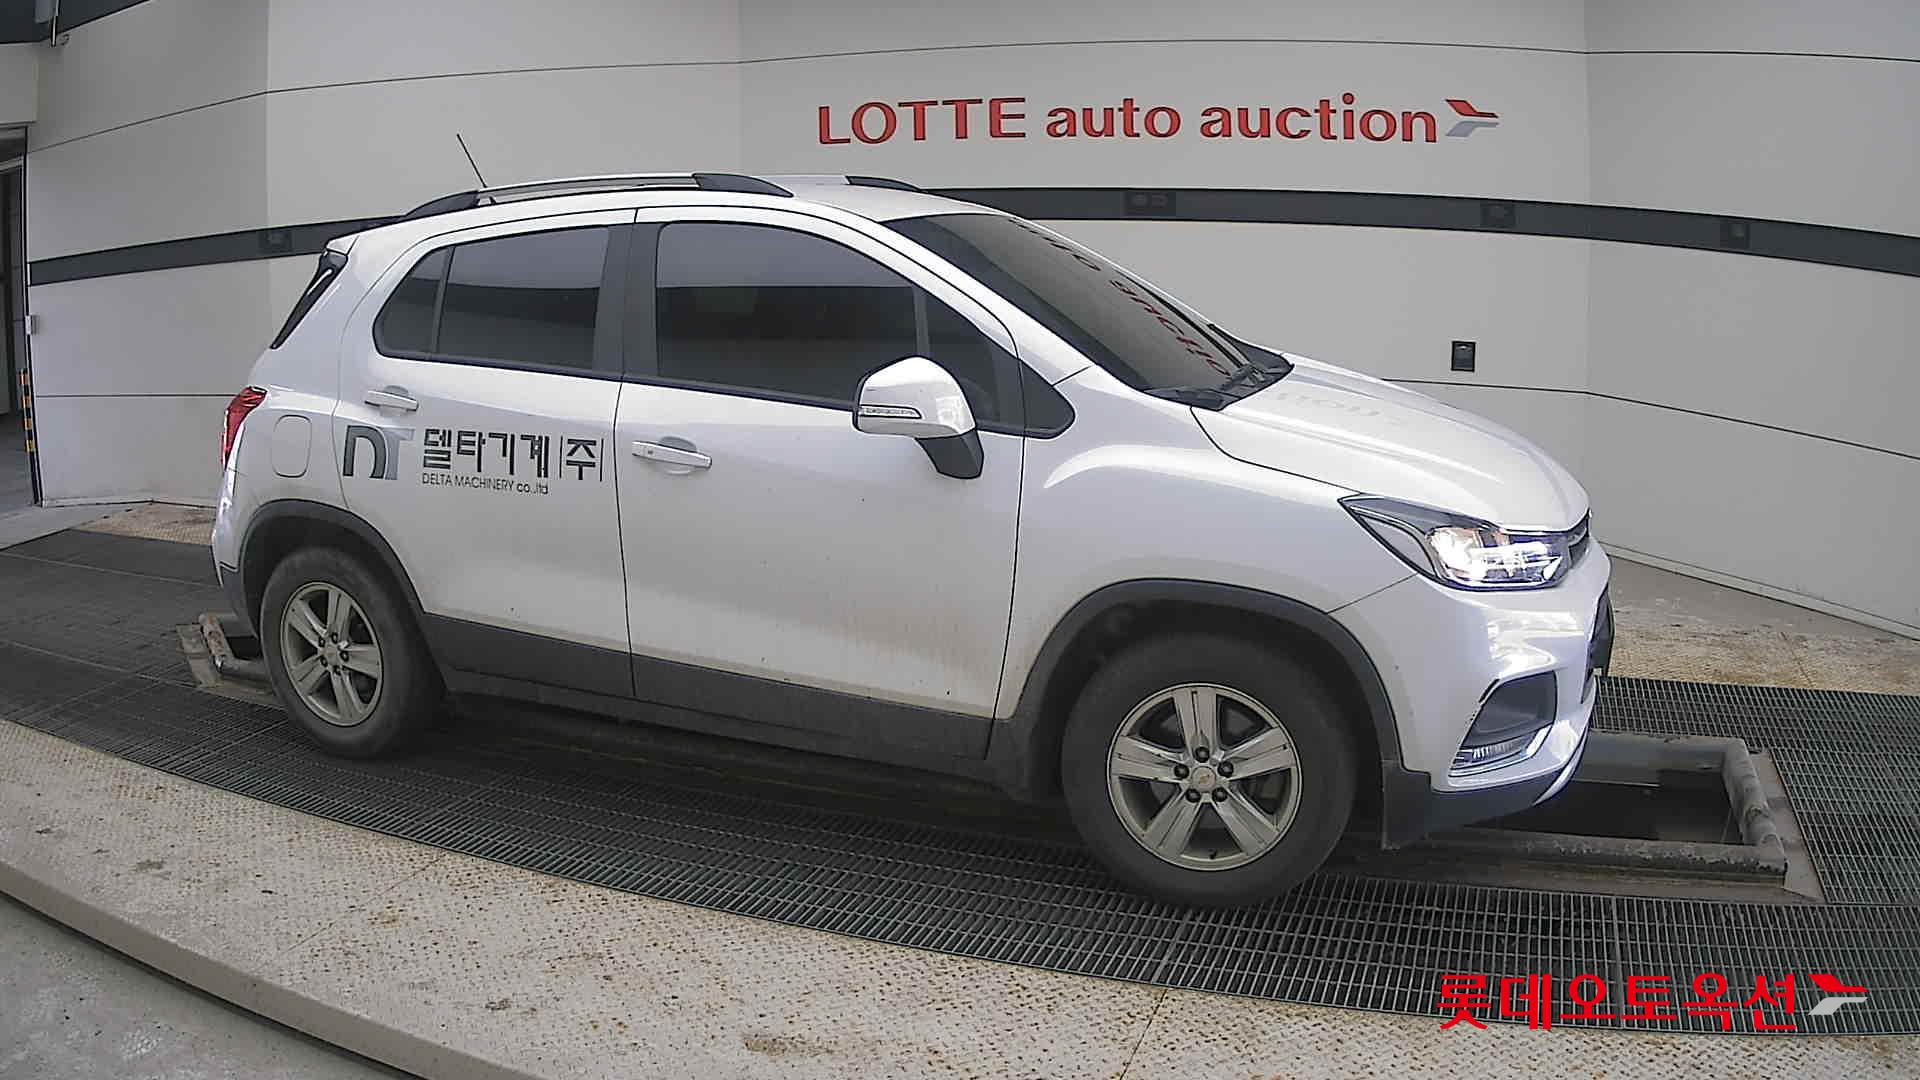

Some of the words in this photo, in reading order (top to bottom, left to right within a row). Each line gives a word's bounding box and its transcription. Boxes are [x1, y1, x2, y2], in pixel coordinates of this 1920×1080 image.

[818, 97, 1026, 145] LOTTE
[1046, 98, 1182, 138] auto
[1200, 93, 1437, 143] auction
[422, 473, 451, 486] DELTA
[455, 475, 514, 491] MACHINERY
